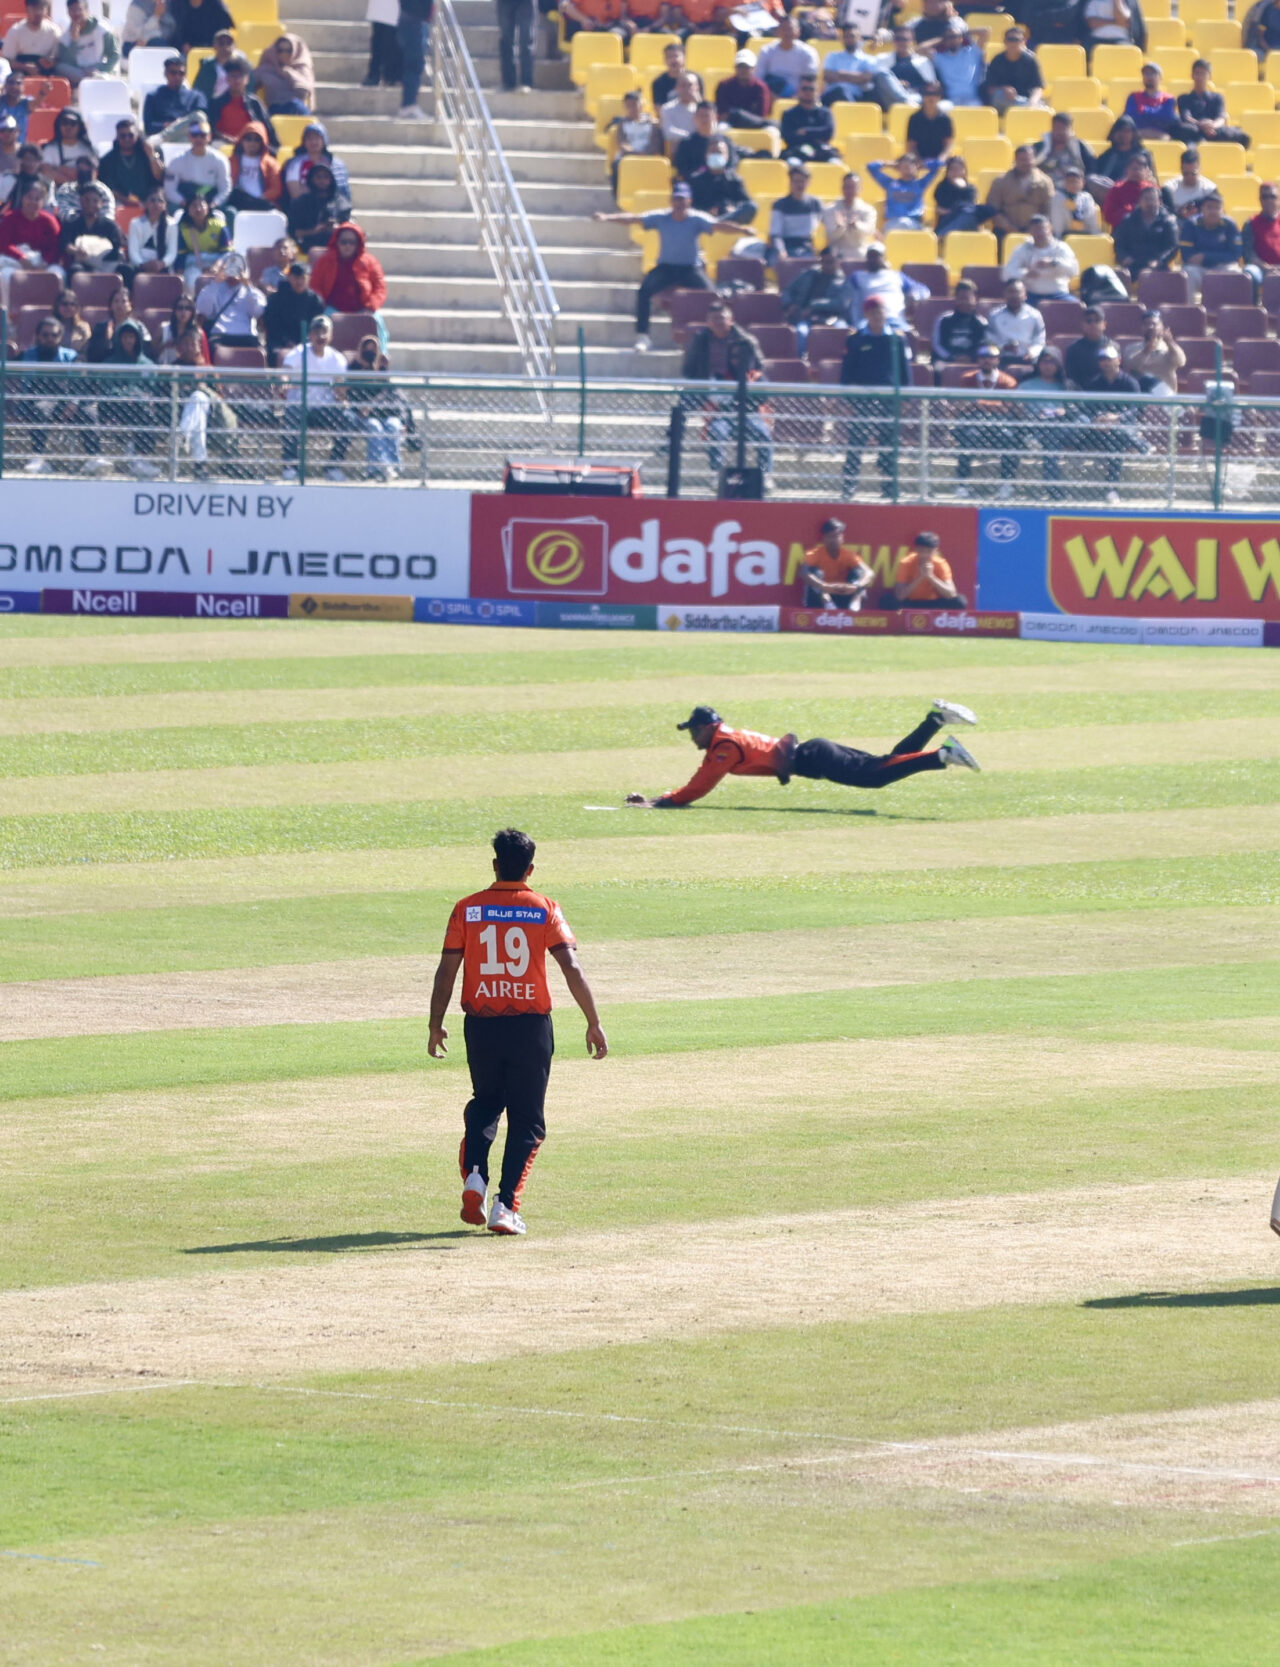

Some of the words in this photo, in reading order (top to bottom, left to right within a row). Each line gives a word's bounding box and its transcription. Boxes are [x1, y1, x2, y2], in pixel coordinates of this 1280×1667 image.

[134, 493, 248, 517] DRIVEN
[256, 495, 294, 519] BY
[228, 550, 438, 580] JAECOO
[1063, 534, 1219, 602] WAI
[72, 589, 137, 612] Ncell
[196, 594, 260, 617] Ncell
[684, 613, 738, 630] Siddhartha
[740, 615, 775, 631] Capital
[487, 909, 513, 918] BLUE
[515, 910, 542, 920] STAR
[479, 924, 530, 977] 19
[475, 980, 536, 1000] AIREE
